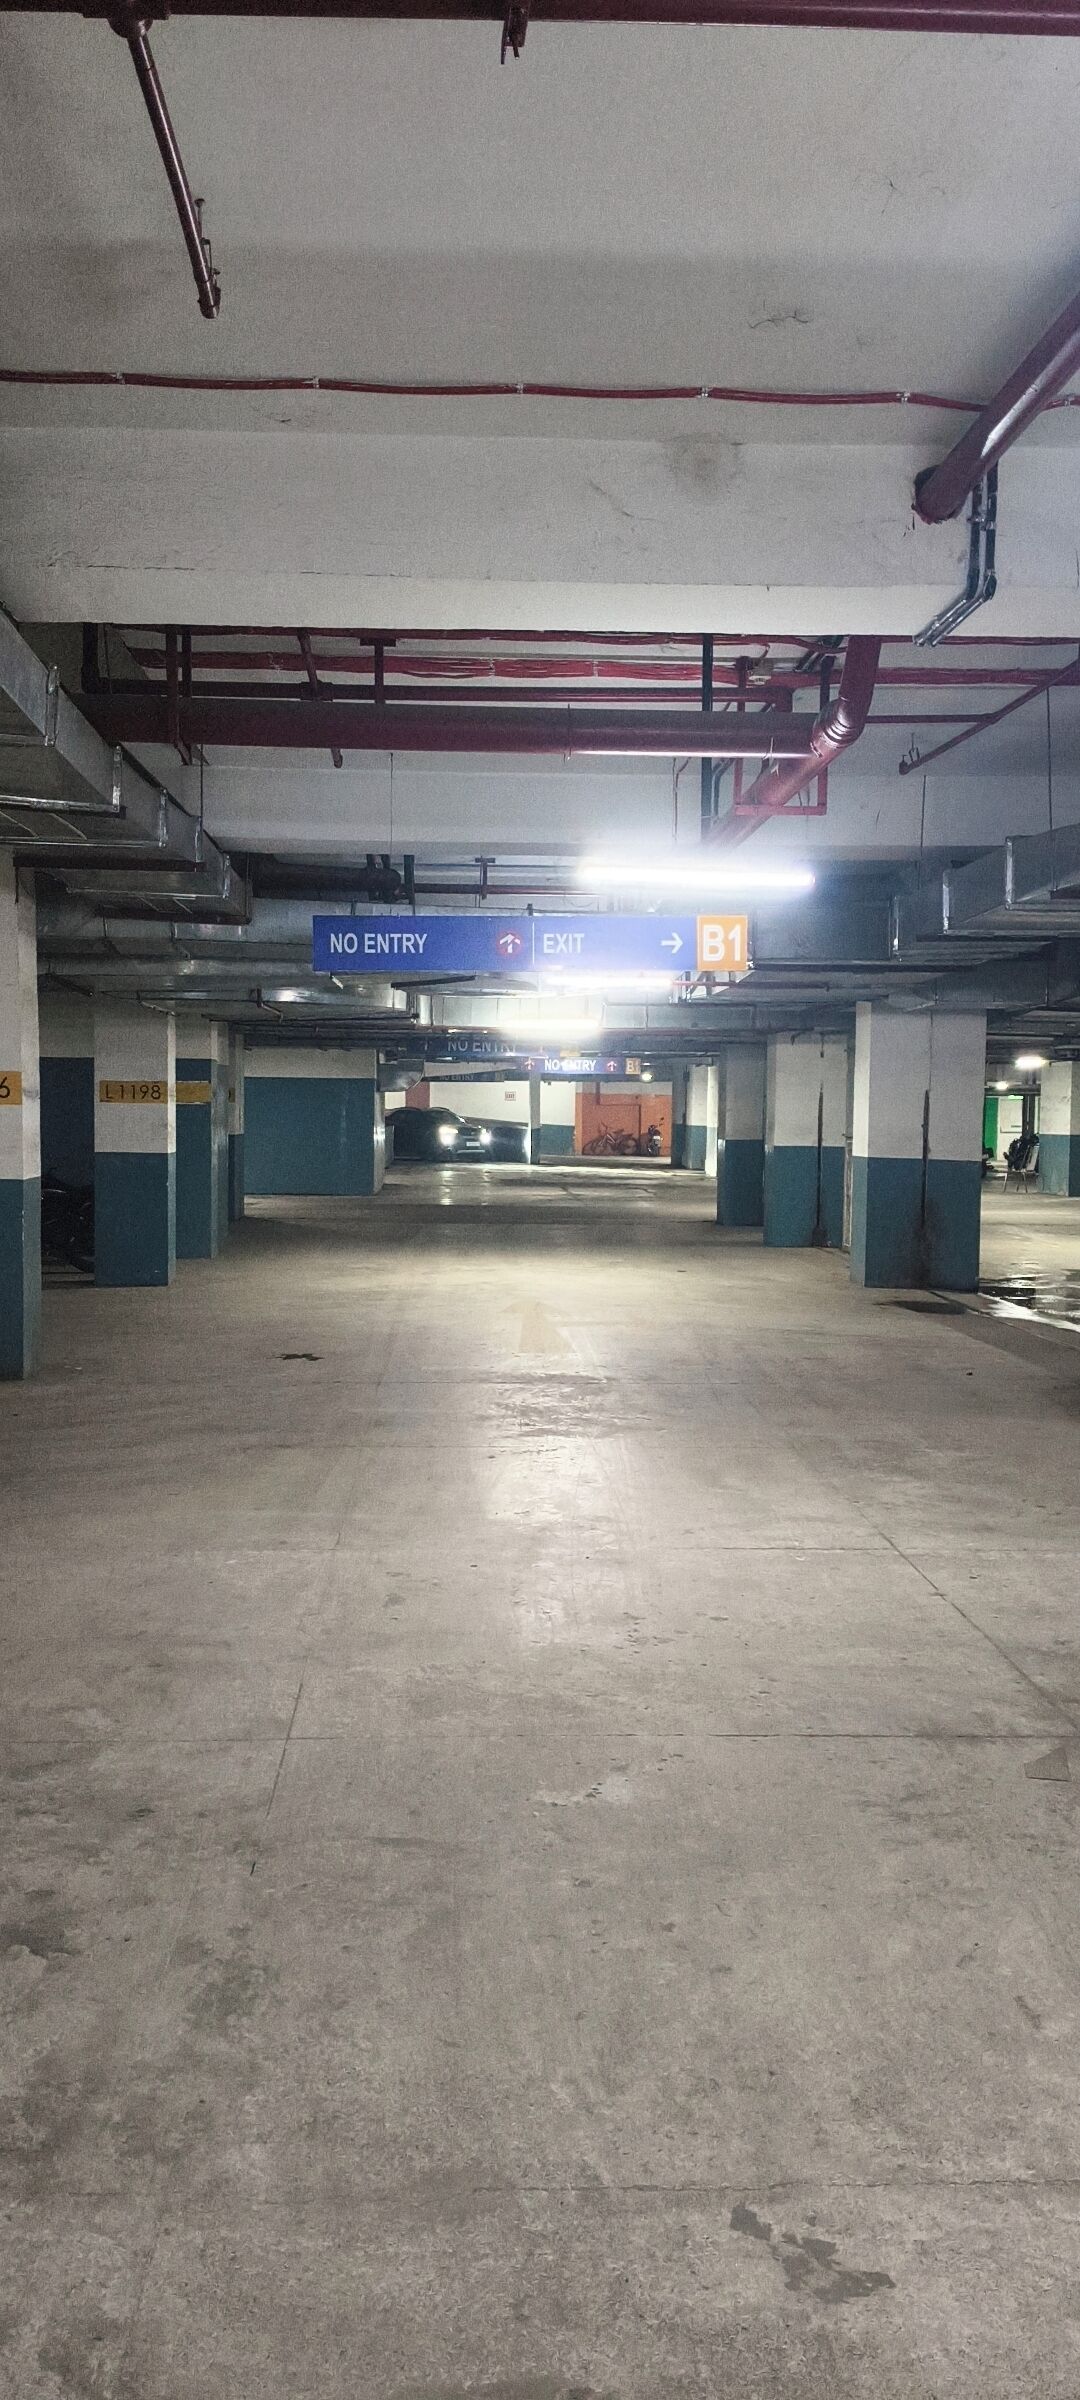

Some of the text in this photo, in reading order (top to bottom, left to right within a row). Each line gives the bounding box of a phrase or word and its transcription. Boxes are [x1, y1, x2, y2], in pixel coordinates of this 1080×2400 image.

[330, 932, 428, 954] NO ENTRY
[543, 933, 585, 954] EXIT
[702, 924, 741, 962] B1
[544, 1058, 597, 1072] NO TRY
[105, 1084, 161, 1100] L1198
